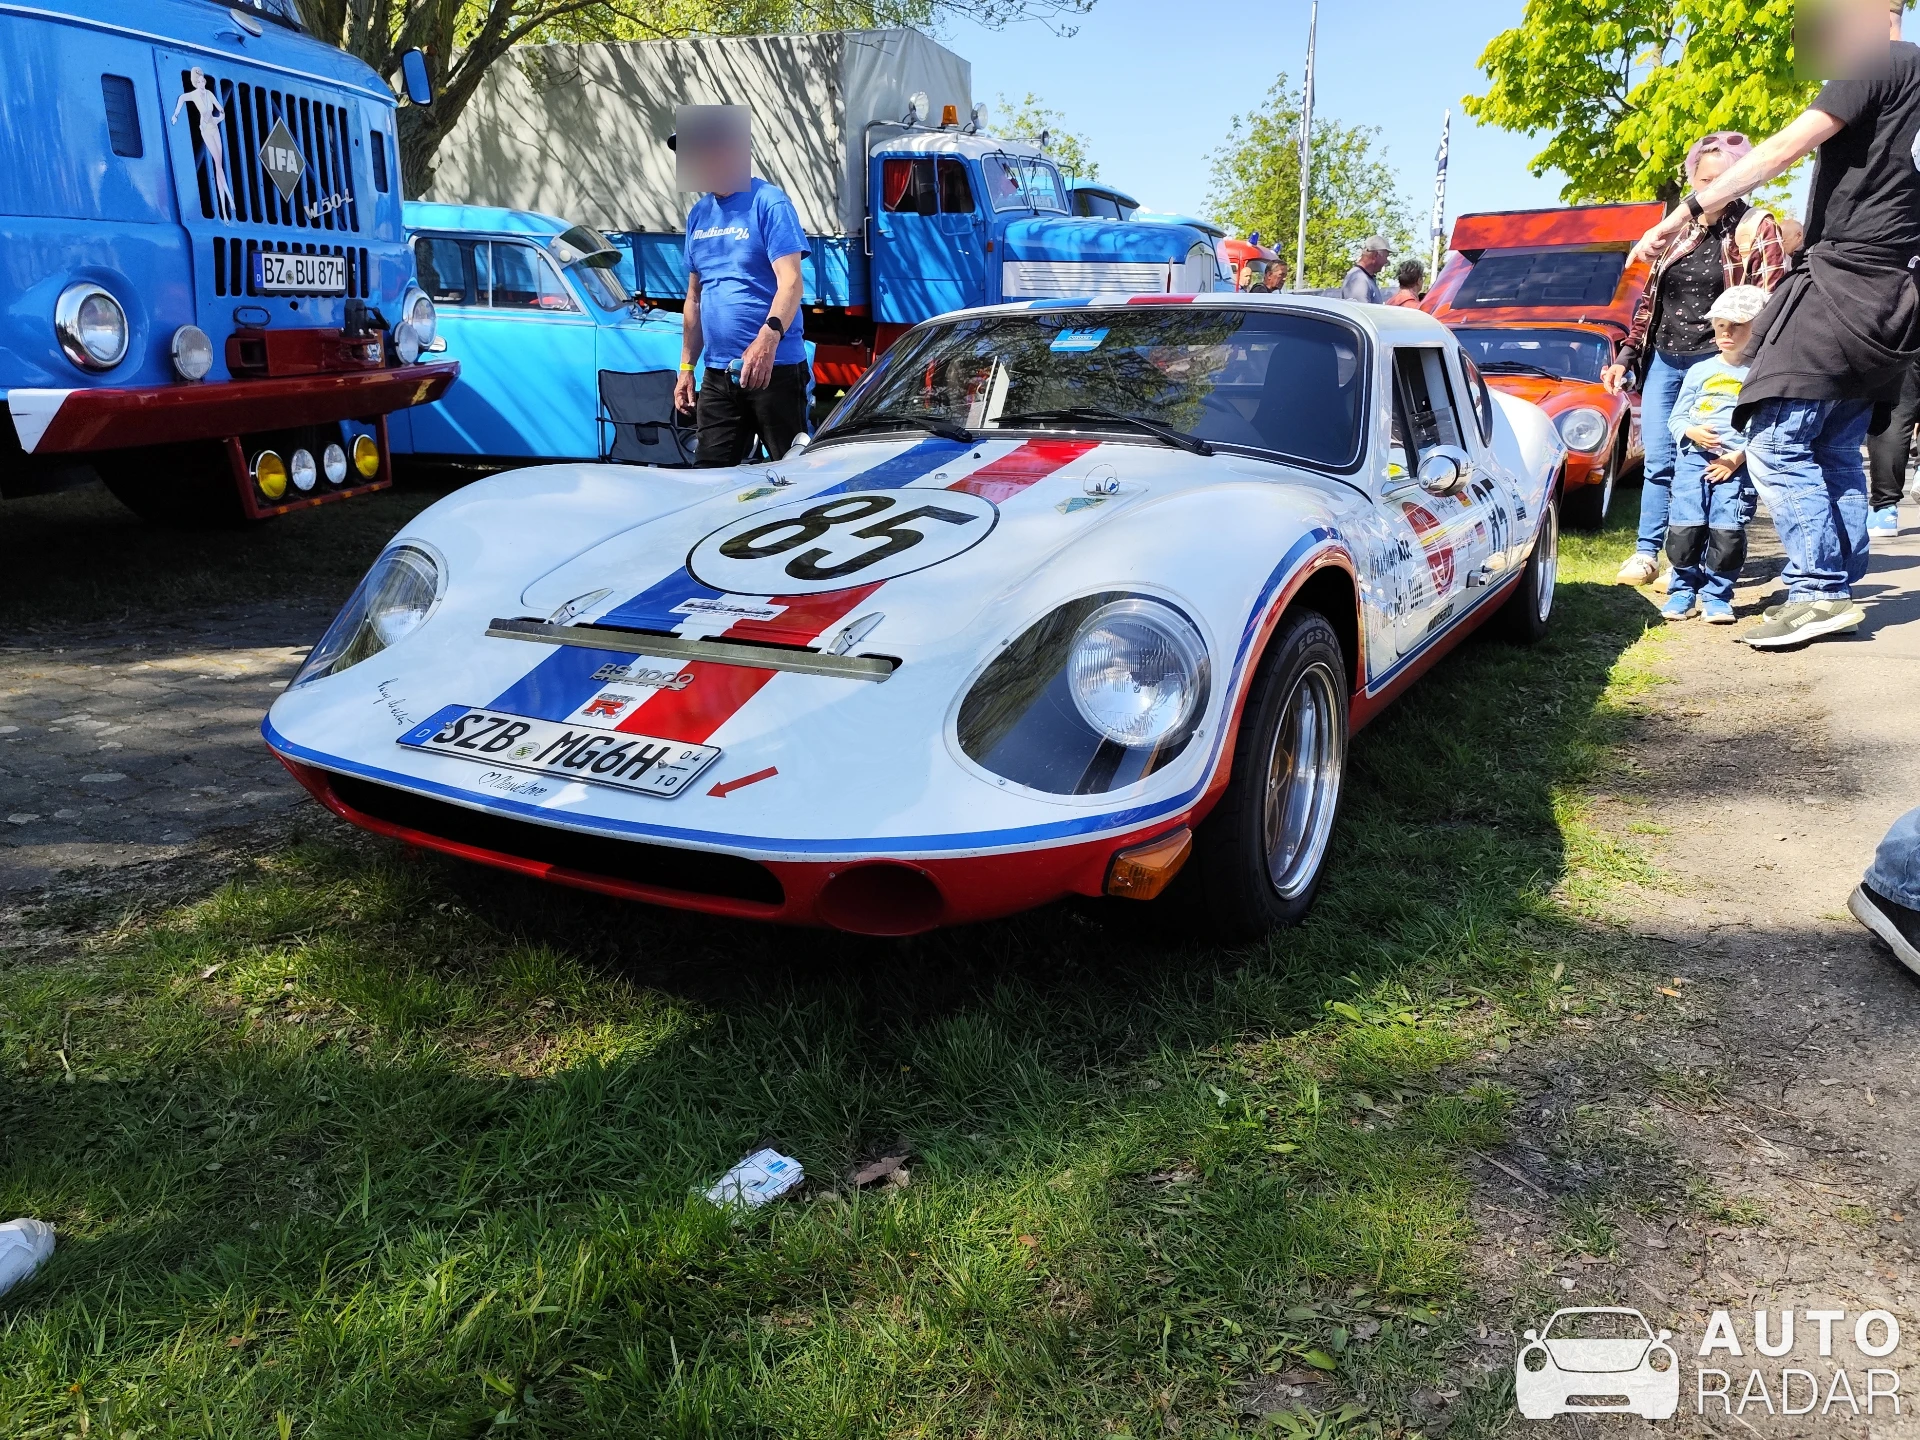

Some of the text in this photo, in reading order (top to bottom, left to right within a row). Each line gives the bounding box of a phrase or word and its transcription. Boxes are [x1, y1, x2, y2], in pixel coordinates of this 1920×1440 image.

[267, 146, 299, 175] IFA
[263, 257, 345, 286] BZ BU 87H
[718, 495, 980, 581] 85
[1297, 629, 1336, 655] ECSTA
[633, 668, 695, 685] 1000
[415, 729, 431, 738] D
[432, 714, 532, 753] SZB
[679, 750, 704, 763] 04
[653, 775, 677, 787] 10
